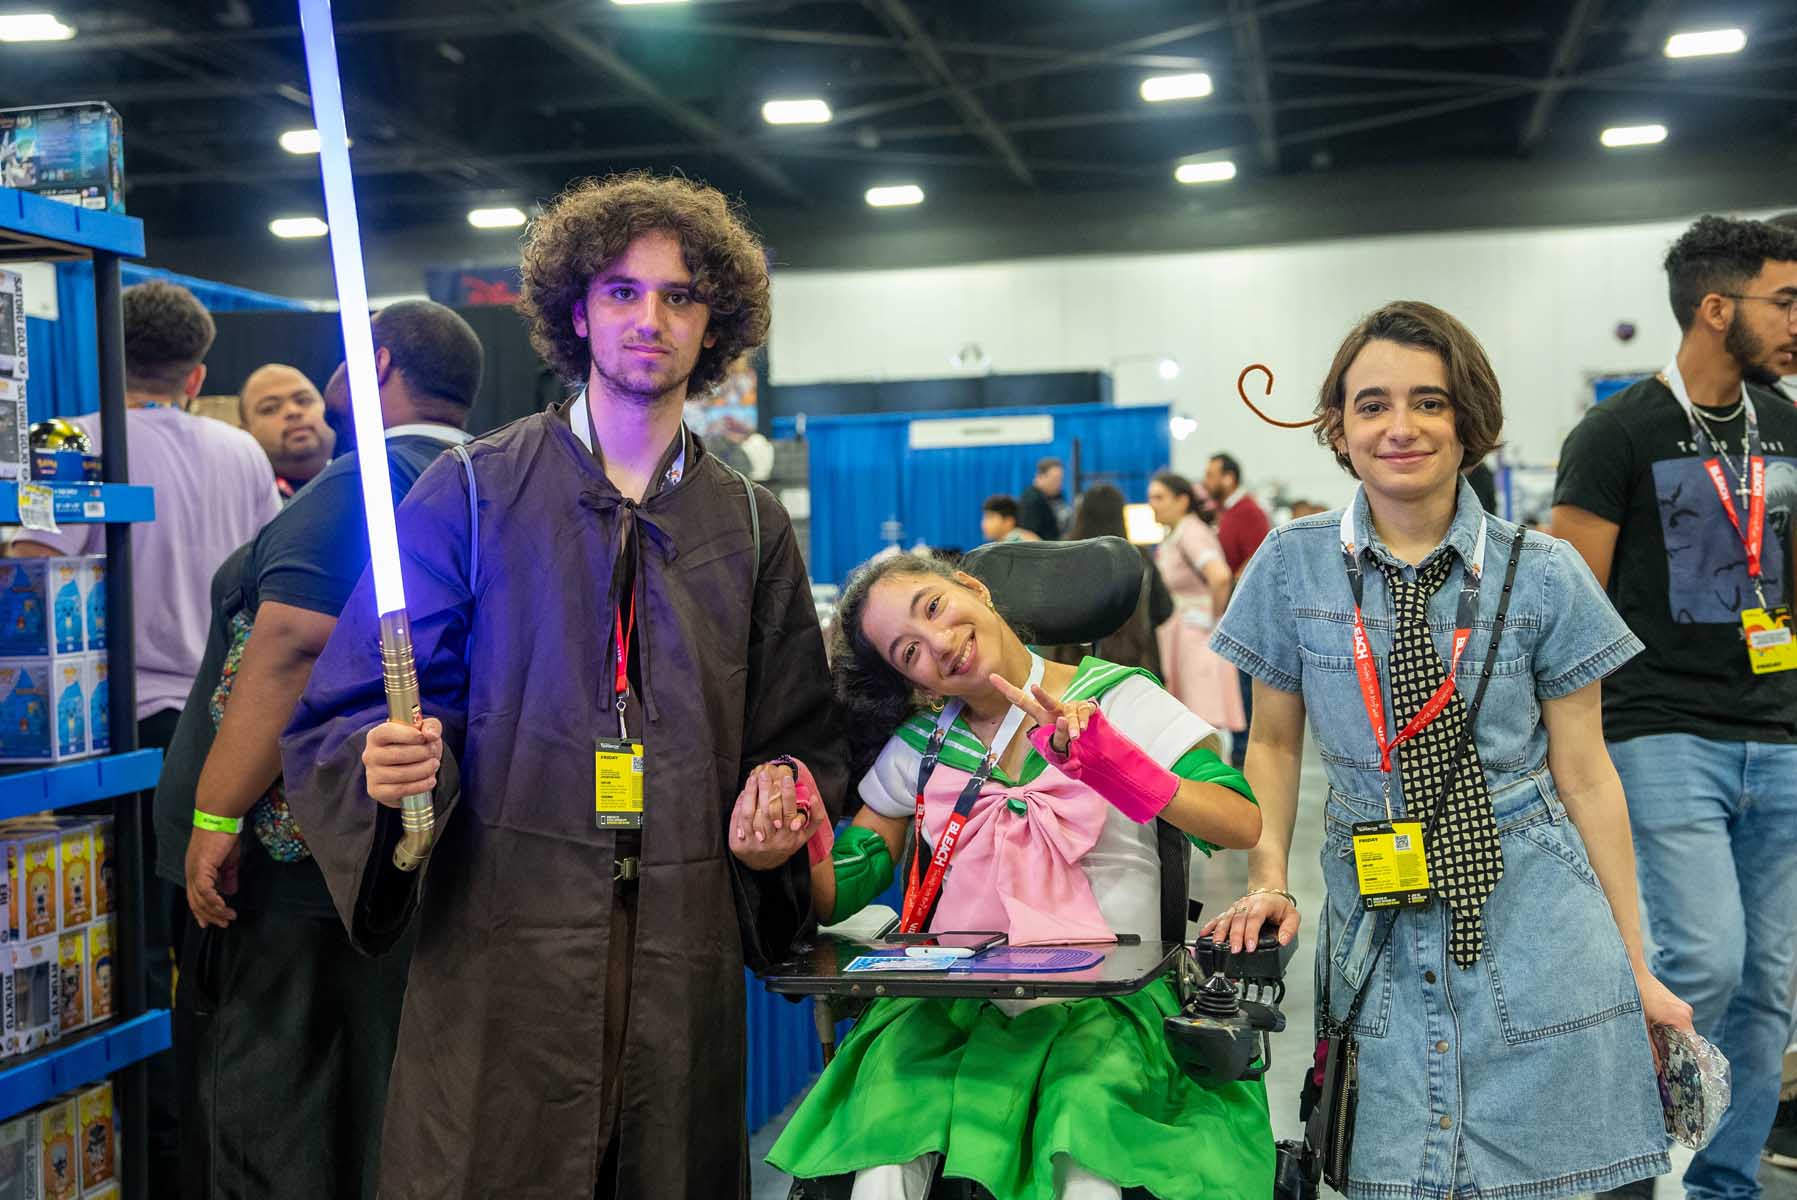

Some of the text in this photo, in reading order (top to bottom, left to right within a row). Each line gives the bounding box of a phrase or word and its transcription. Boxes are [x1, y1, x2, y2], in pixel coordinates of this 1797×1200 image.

[14, 277, 26, 358] SATORU GOJO
[17, 385, 29, 464] SATORU GOJO
[934, 820, 961, 868] BLEACH
[5, 975, 14, 1029] RYUKYU
